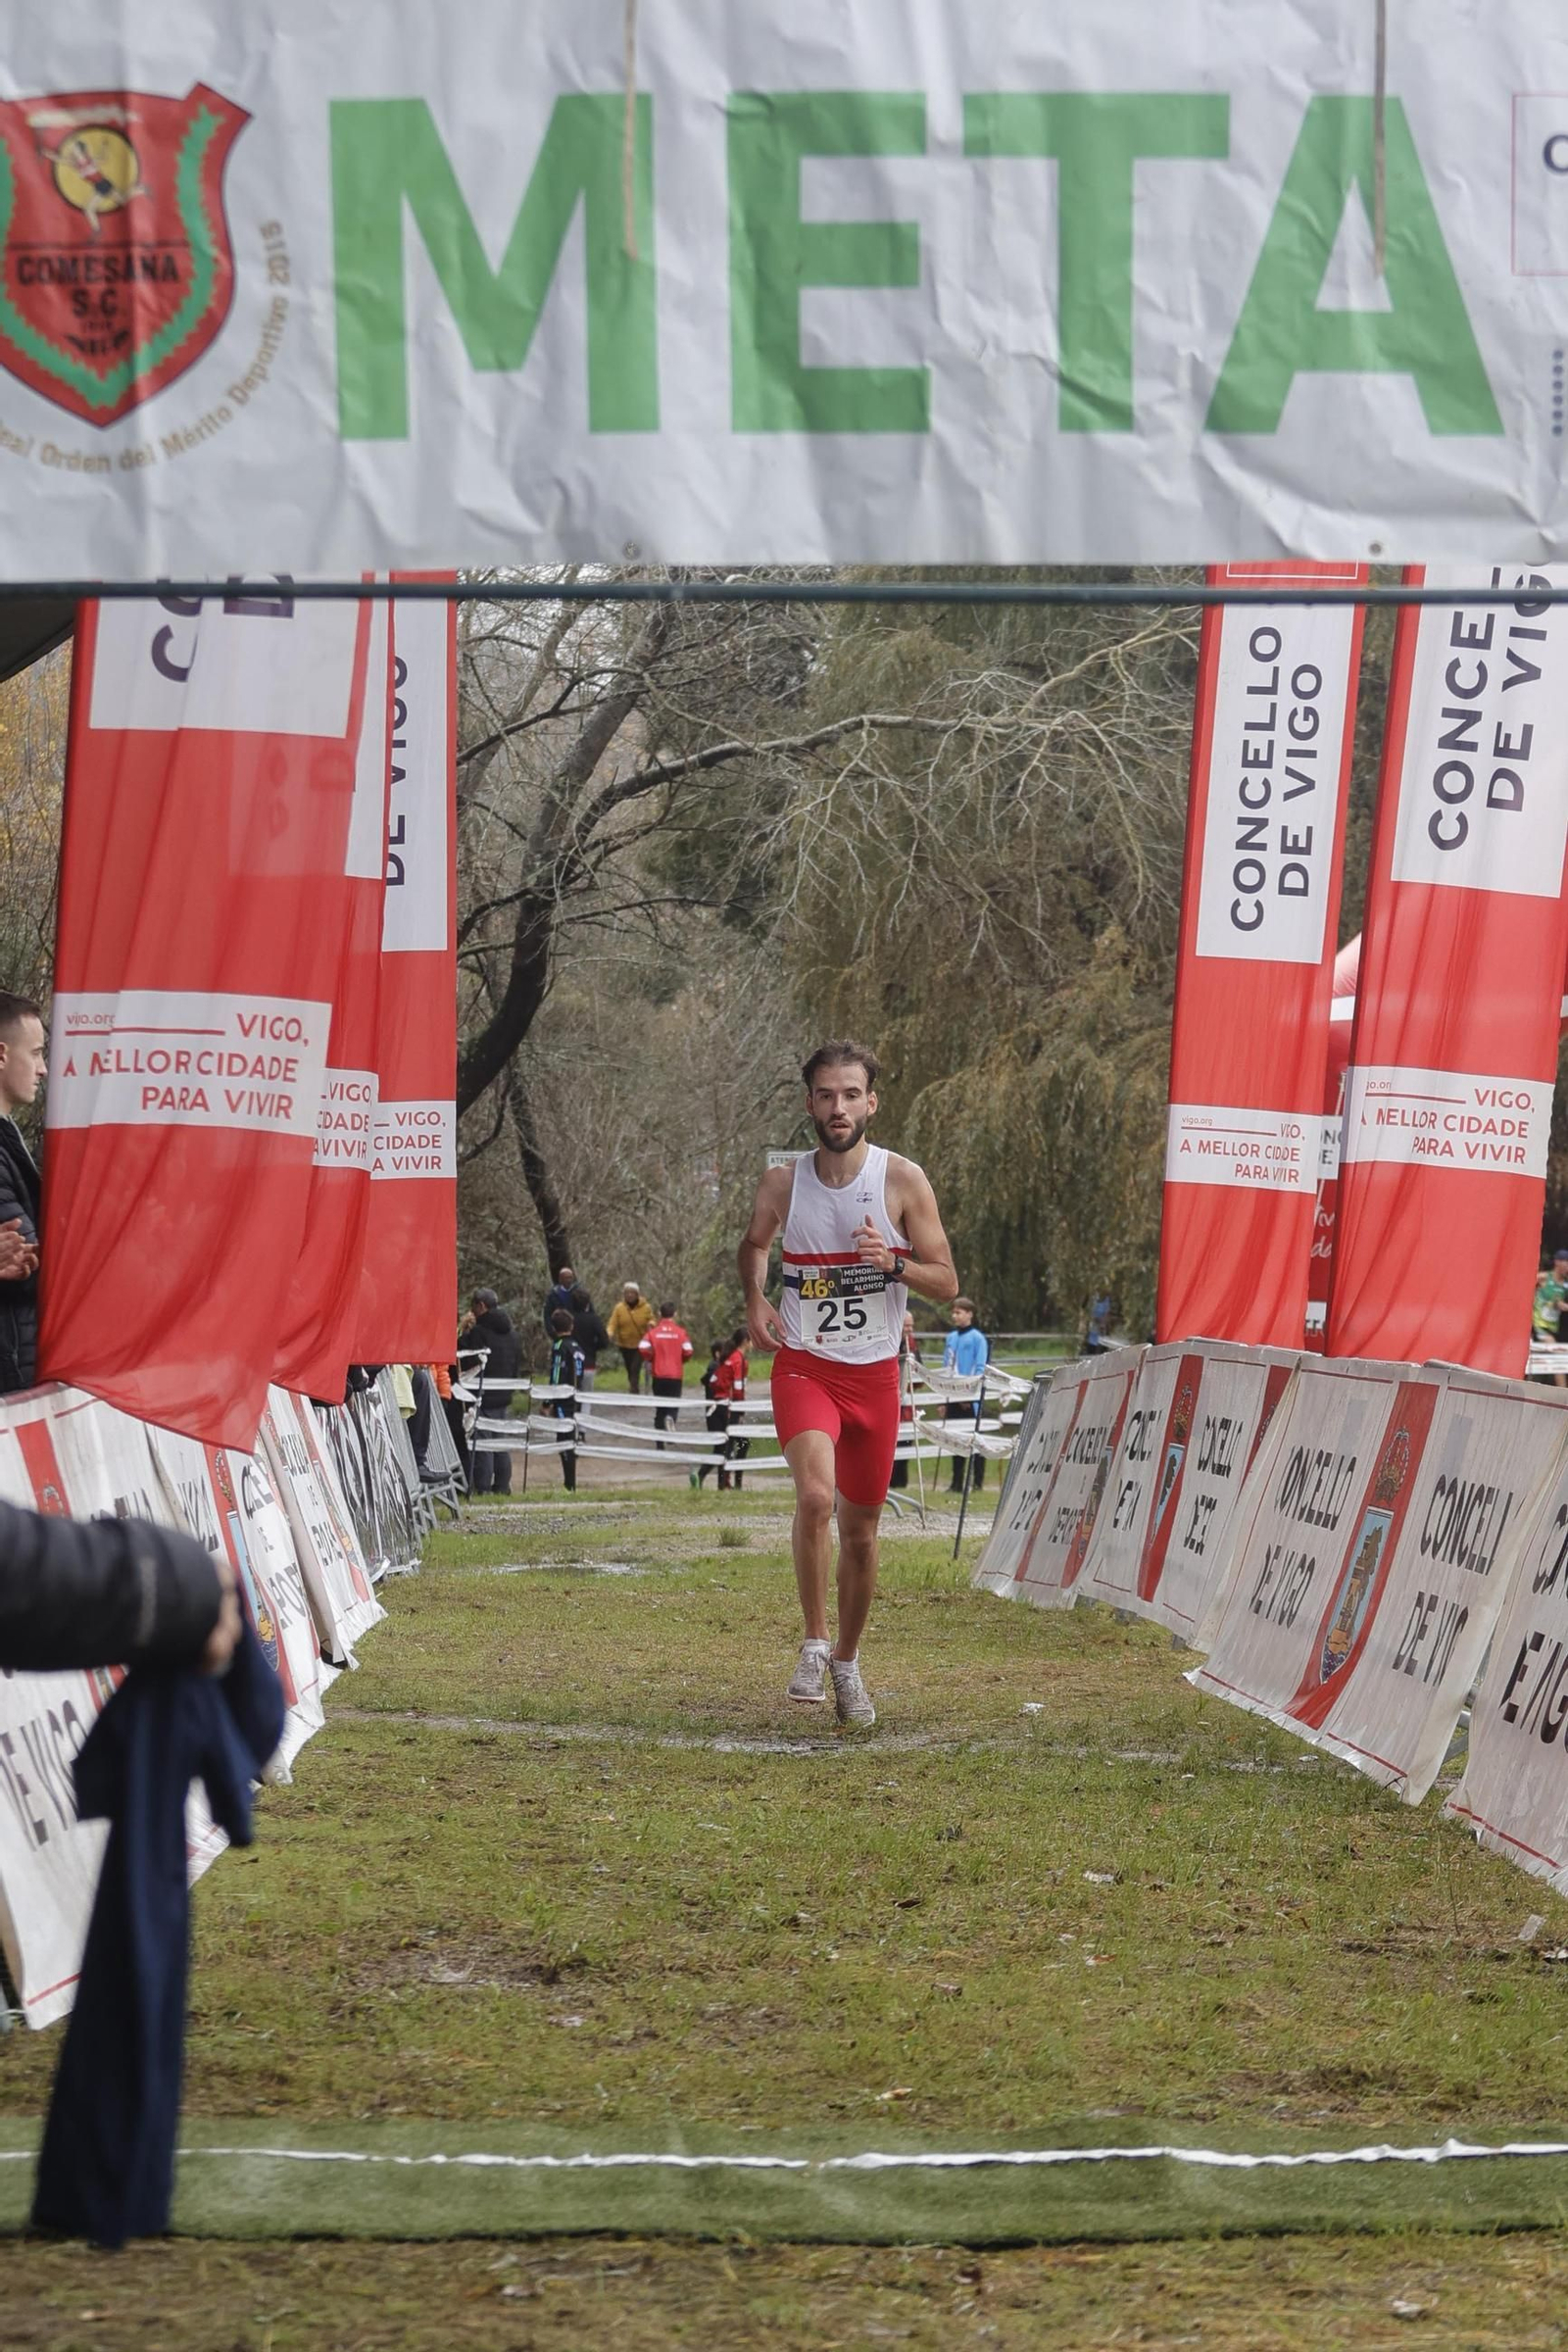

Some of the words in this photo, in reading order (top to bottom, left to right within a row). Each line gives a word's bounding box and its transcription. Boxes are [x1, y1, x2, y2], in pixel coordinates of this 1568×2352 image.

[329, 92, 1505, 440] META
[40, 442, 112, 472] Orden
[118, 442, 156, 471] del
[226, 295, 289, 406] Deportivo
[1283, 663, 1323, 802] VIGO
[1231, 626, 1282, 932] CONCELLO
[1486, 720, 1534, 812] DE
[1278, 825, 1313, 898] DE
[236, 1012, 309, 1048] VIGO,
[197, 1051, 299, 1083] CIDADE
[140, 1086, 211, 1112] PARA
[223, 1089, 293, 1120] VIVIR
[1474, 1088, 1535, 1113] VIGO,
[395, 1111, 447, 1128] VIGO,
[1181, 1115, 1213, 1127] vigo.org
[1443, 1114, 1530, 1139] CIDADE
[321, 1138, 368, 1160] VIVIR
[373, 1134, 442, 1152] CIDADE
[1179, 1139, 1192, 1153] A
[1198, 1140, 1260, 1158] MELLOR
[1412, 1136, 1455, 1157] PARA
[1464, 1141, 1527, 1164] VIVIR
[392, 1155, 442, 1171] VIVIR
[1235, 1163, 1269, 1181] PARA
[841, 1274, 884, 1286] BELARMINO
[854, 1282, 884, 1293] ALONSO
[817, 1298, 867, 1333] 25
[1392, 1591, 1439, 1676] DE
